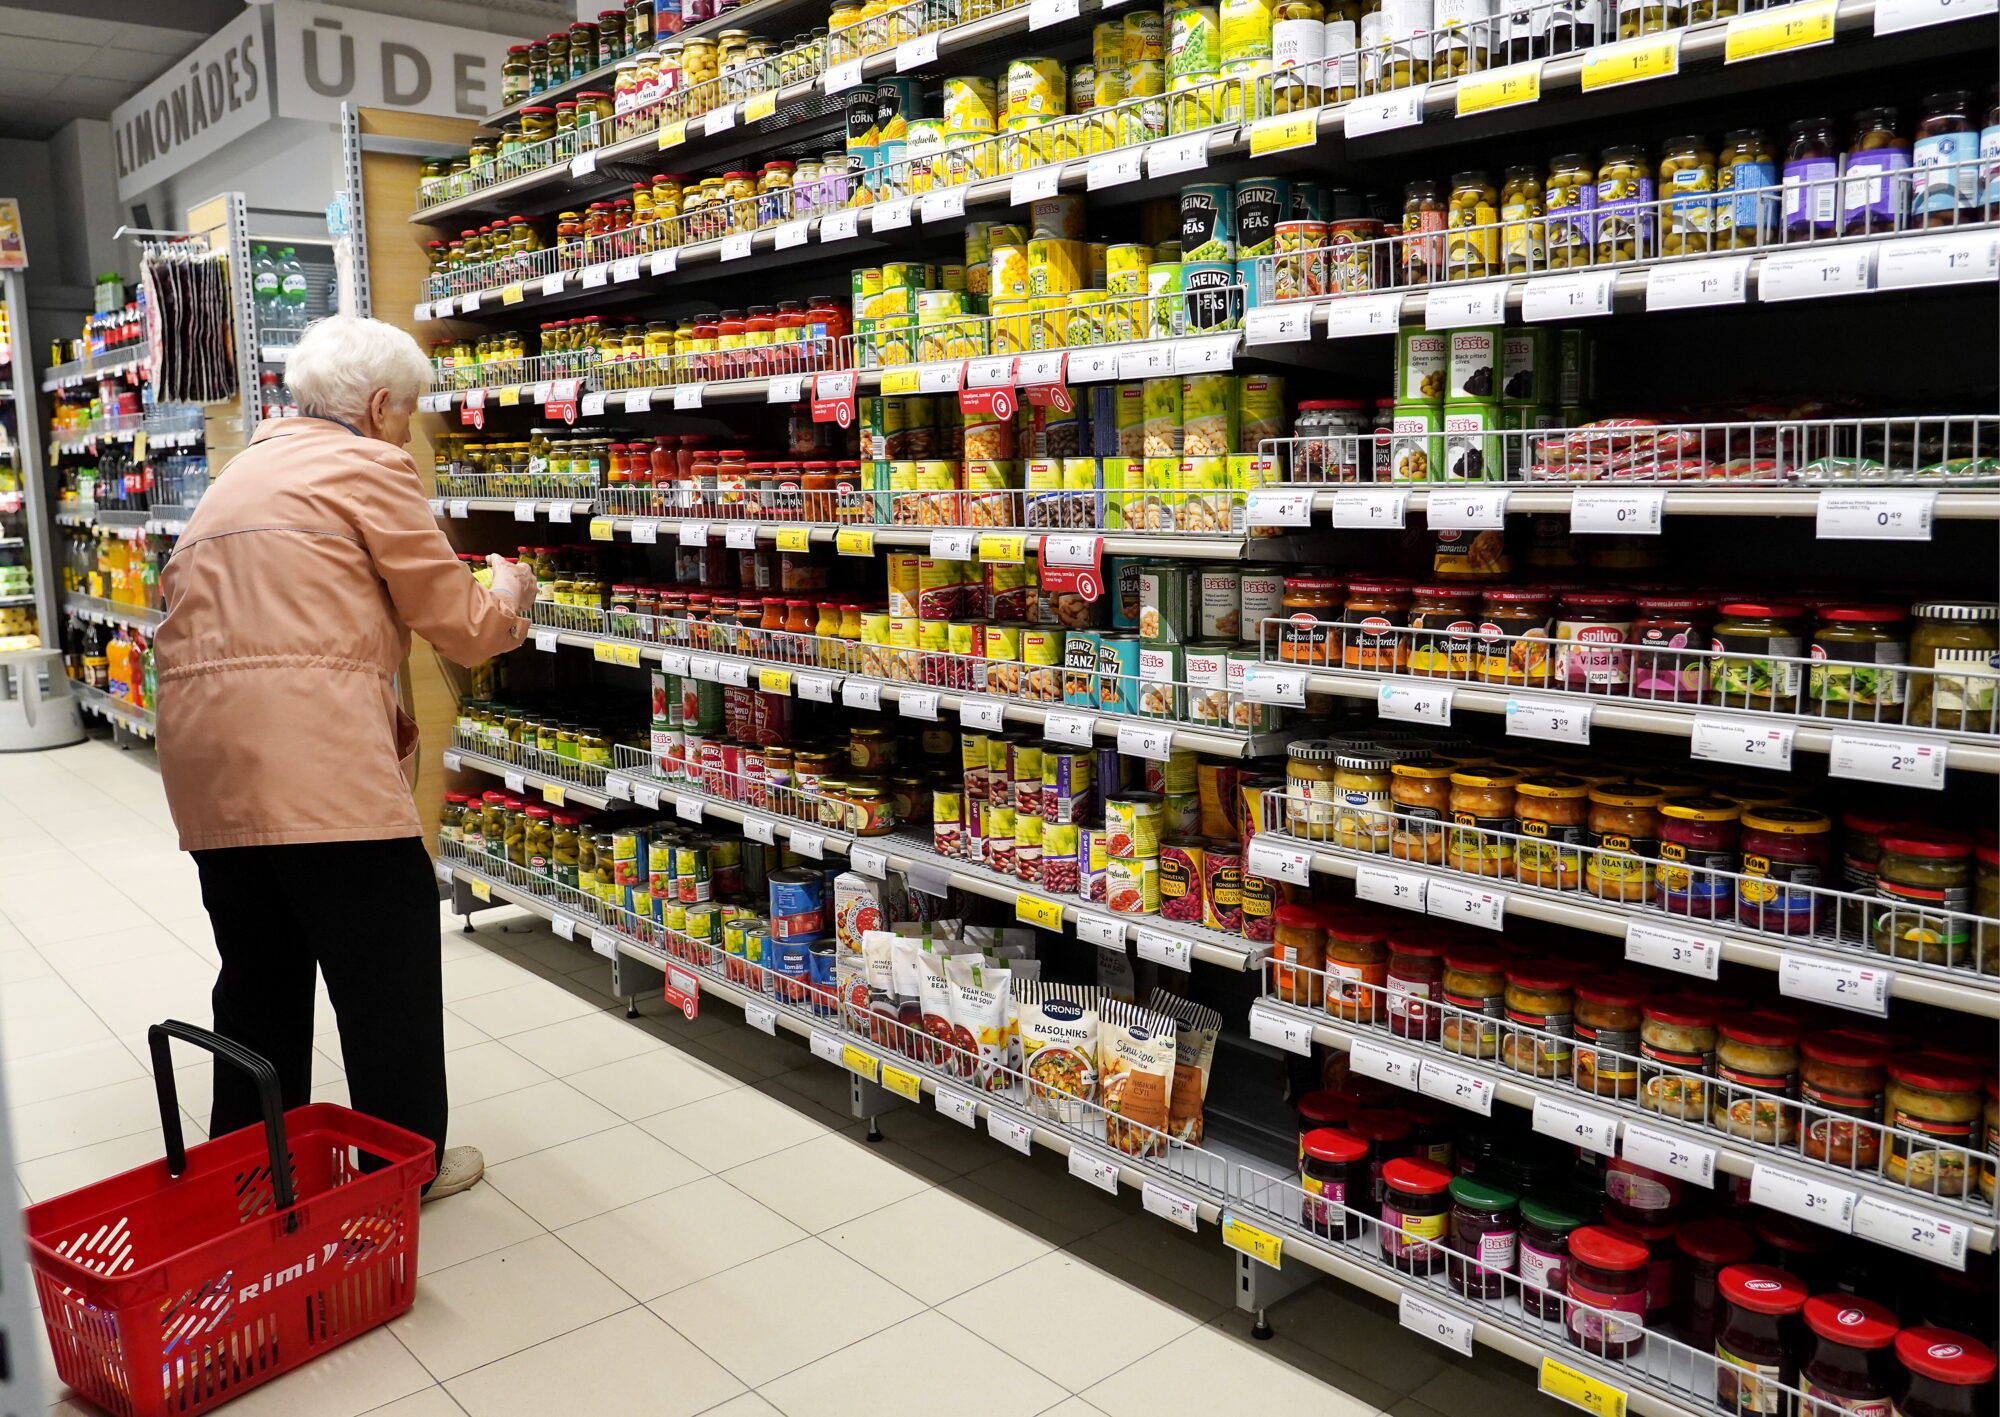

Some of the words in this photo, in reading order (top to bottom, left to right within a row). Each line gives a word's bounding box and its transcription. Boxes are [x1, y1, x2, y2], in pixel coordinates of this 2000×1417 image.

[1276, 40, 1298, 49] QUEEN
[877, 86, 895, 99] EINZ
[116, 34, 259, 178] LIMONĀDES
[850, 112, 874, 124] CORN
[1238, 190, 1275, 205] HEINZ
[1183, 222, 1205, 235] PEAS
[1242, 216, 1269, 229] PEAS
[1191, 273, 1229, 288] HEINZ
[1454, 336, 1490, 350] Basic
[1504, 342, 1529, 353] asic
[1204, 578, 1236, 590] Basic
[1244, 581, 1276, 593] Basic
[1581, 631, 1618, 642] spilva
[1066, 655, 1095, 667] BEANZ
[1188, 659, 1217, 672] Basic
[1591, 672, 1608, 682] zupa
[1346, 796, 1368, 804] KRONIS
[1455, 815, 1473, 826] KOK
[1525, 823, 1544, 834] KOK
[1605, 836, 1627, 848] KOK
[1662, 845, 1682, 857] KOK
[1745, 857, 1766, 869] KOK
[1245, 880, 1262, 889] KOK
[960, 985, 978, 995] VEGAN
[962, 993, 977, 1003] BEAN
[978, 997, 993, 1006] SOUP
[1044, 1003, 1081, 1016] KRONIS
[1034, 1024, 1088, 1039] RASOĻNIKS
[1130, 1027, 1149, 1039] KRONIS
[1485, 1237, 1514, 1250] Basic
[239, 1252, 316, 1305] Rimi
